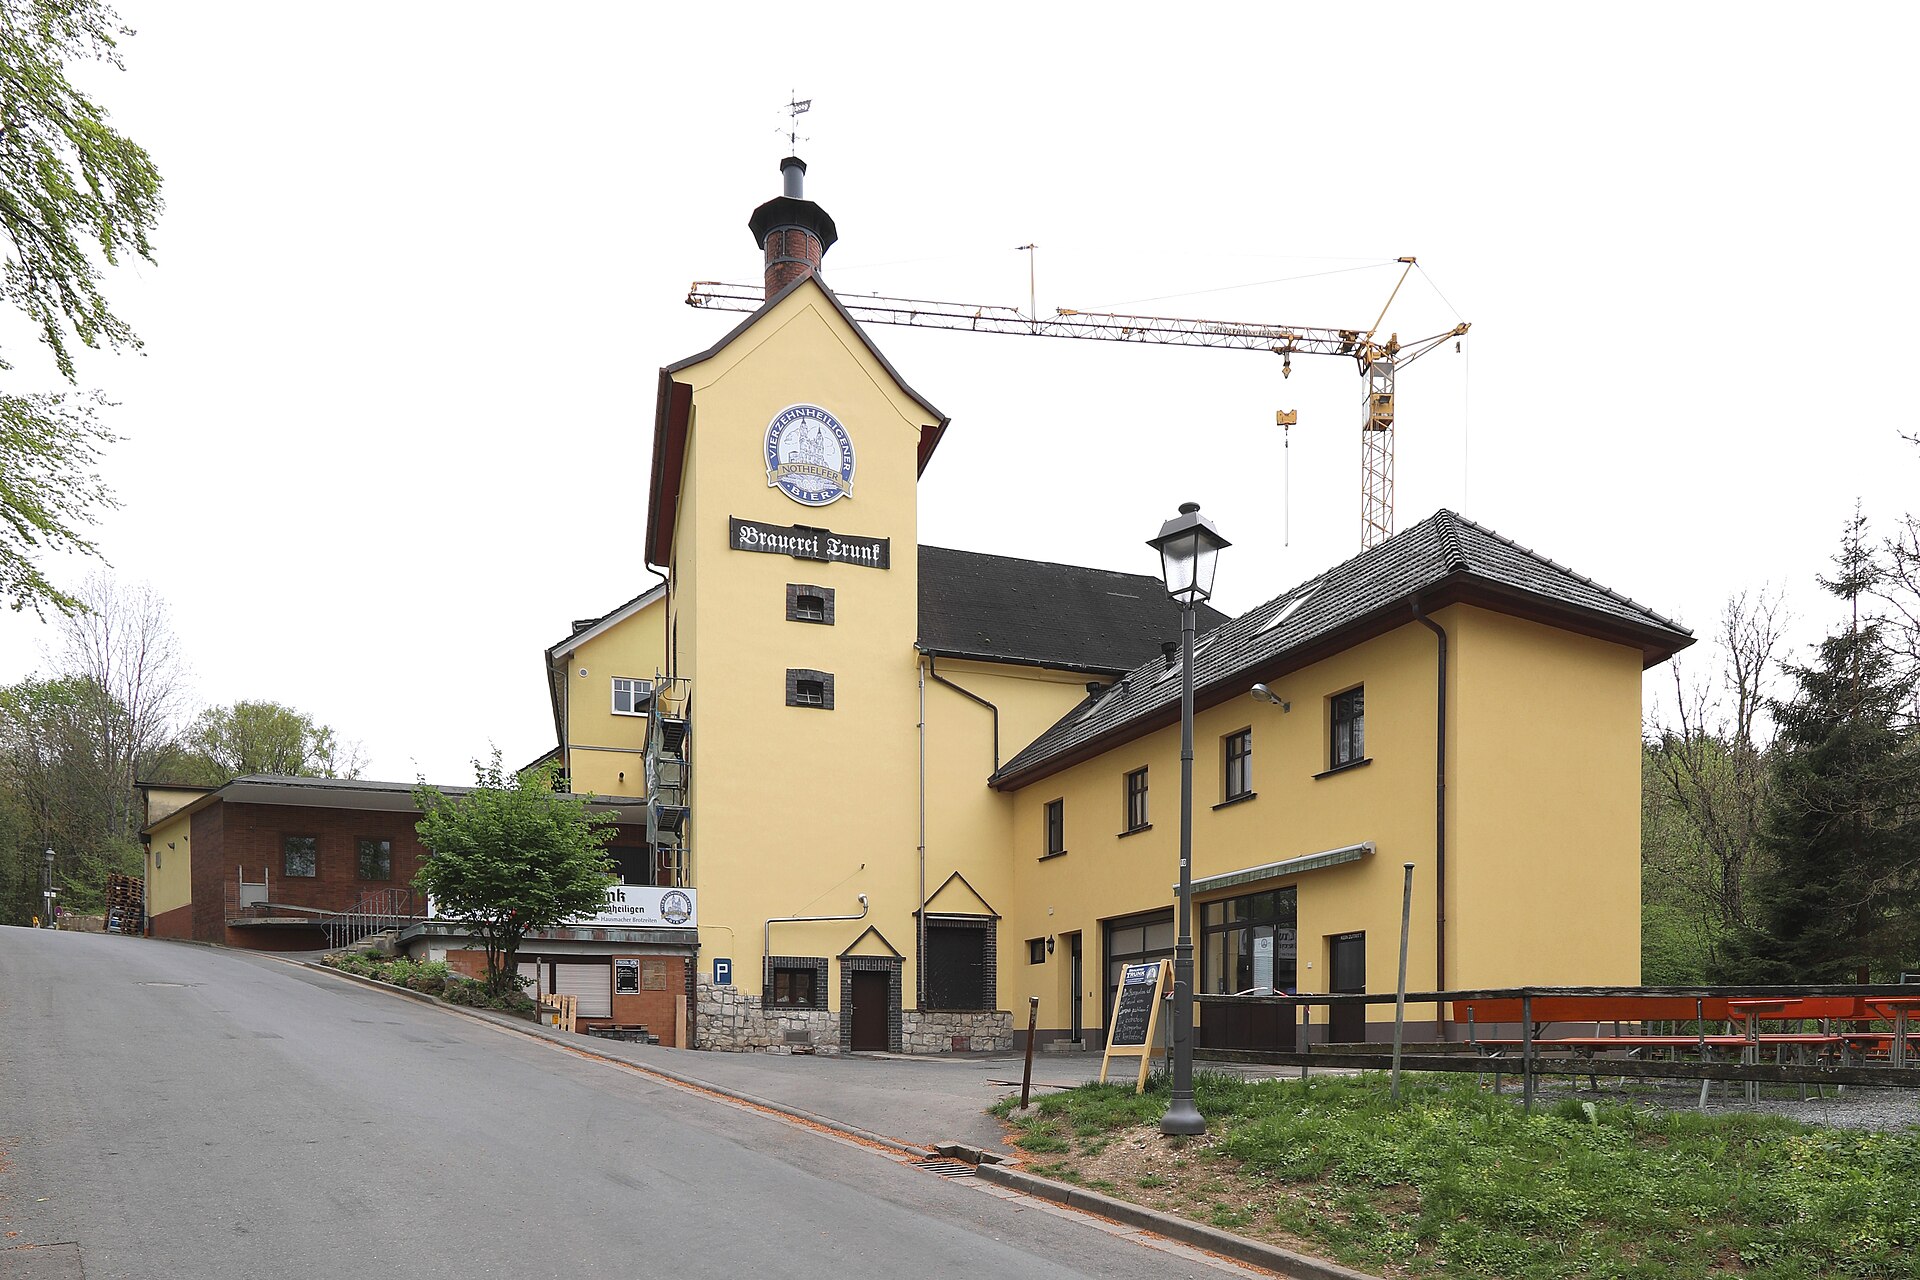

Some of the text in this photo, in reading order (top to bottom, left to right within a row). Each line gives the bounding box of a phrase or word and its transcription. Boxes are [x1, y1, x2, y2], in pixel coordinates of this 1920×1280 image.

[768, 408, 851, 471] VIERZEHNHEILIGENER
[782, 465, 838, 481] NOTHELFER
[791, 486, 830, 500] BIER
[739, 525, 881, 560] Brauerei Trunk
[717, 963, 728, 981] P
[1126, 971, 1145, 979] TRUNK
